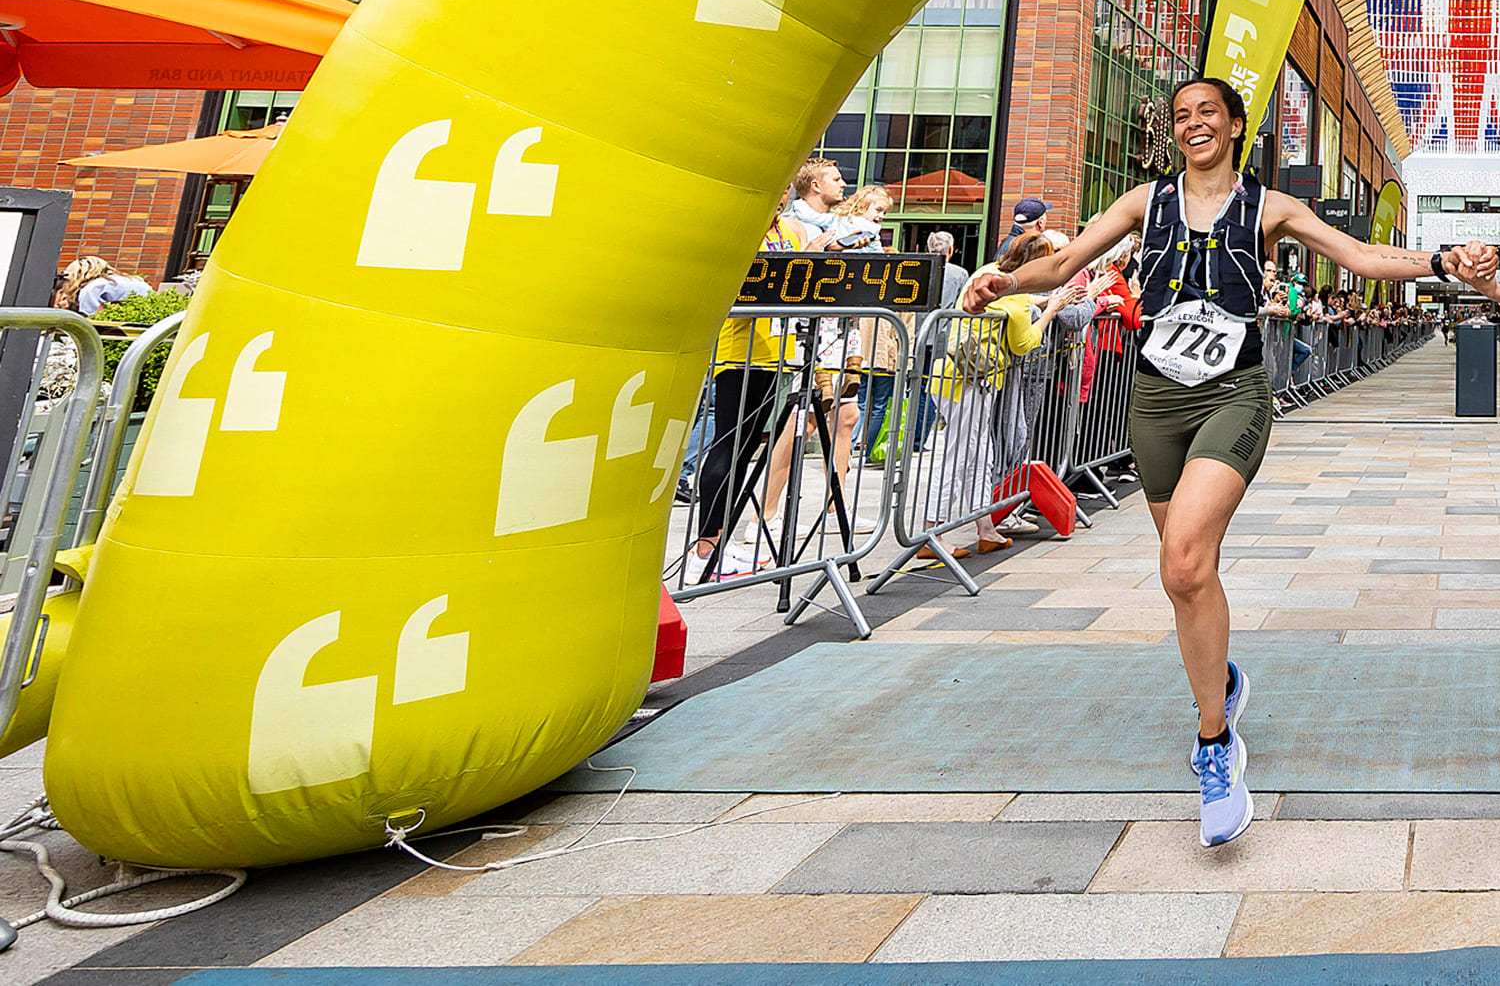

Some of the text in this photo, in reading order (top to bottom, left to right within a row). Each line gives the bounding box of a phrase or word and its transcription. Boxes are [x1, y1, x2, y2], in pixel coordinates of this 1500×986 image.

[1228, 62, 1249, 91] HE
[1177, 313, 1214, 324] LEXICON
[1161, 322, 1229, 367] 726
[1229, 427, 1260, 462] PUMA
